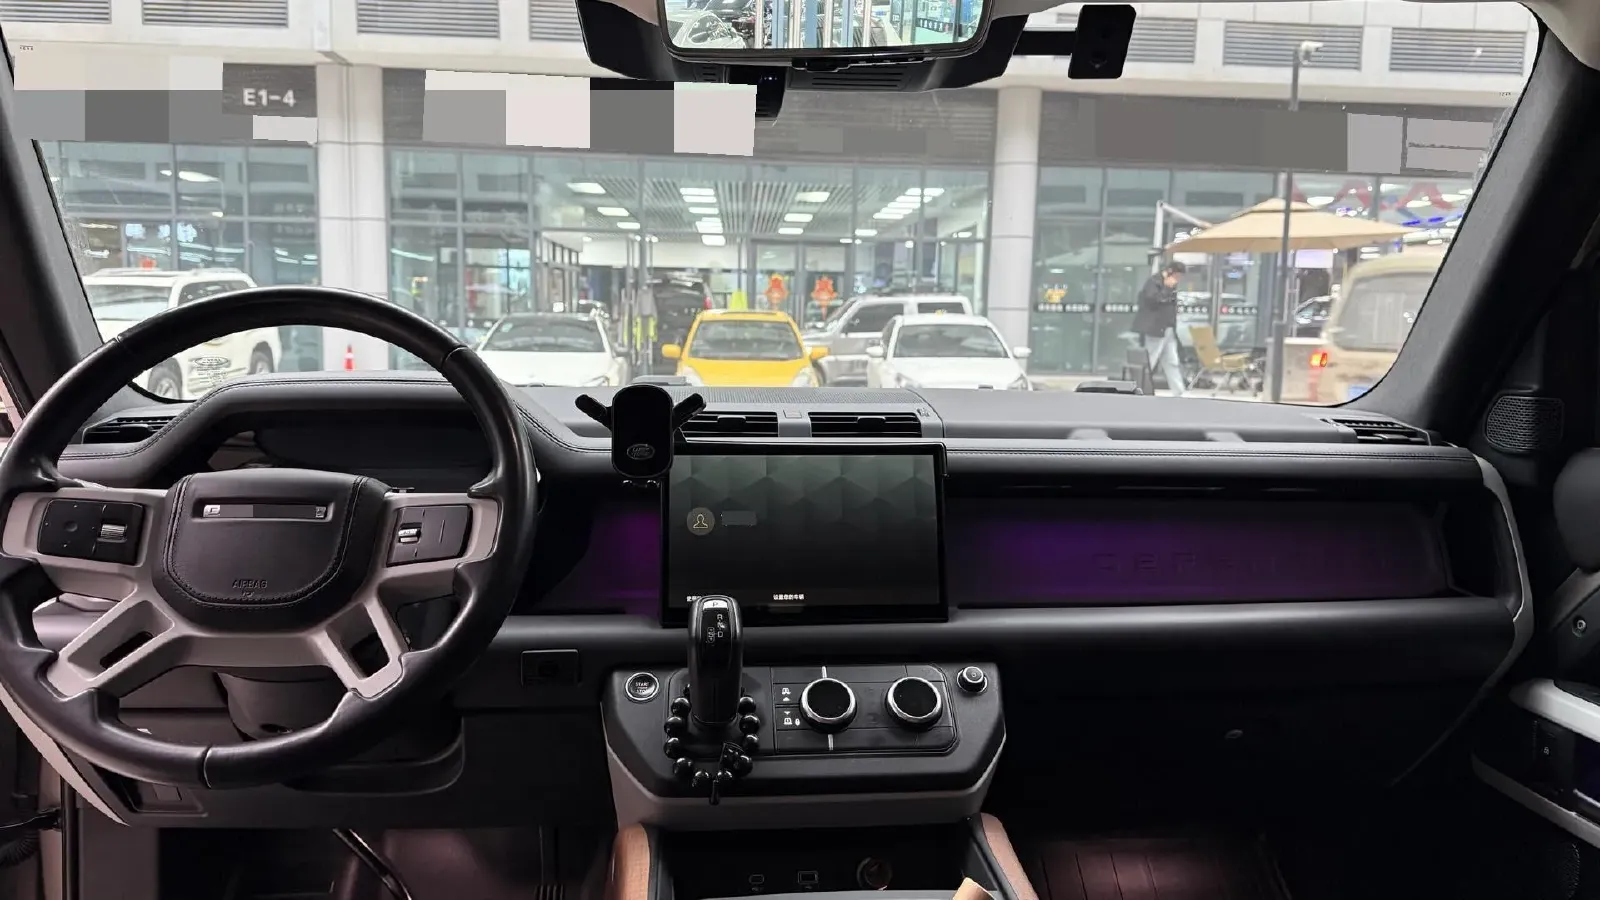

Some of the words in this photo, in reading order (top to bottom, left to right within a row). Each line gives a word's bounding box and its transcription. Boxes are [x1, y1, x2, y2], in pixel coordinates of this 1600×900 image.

[243, 88, 297, 107] E1-4
[232, 579, 268, 589] AIRBAG
[717, 630, 724, 638] D
